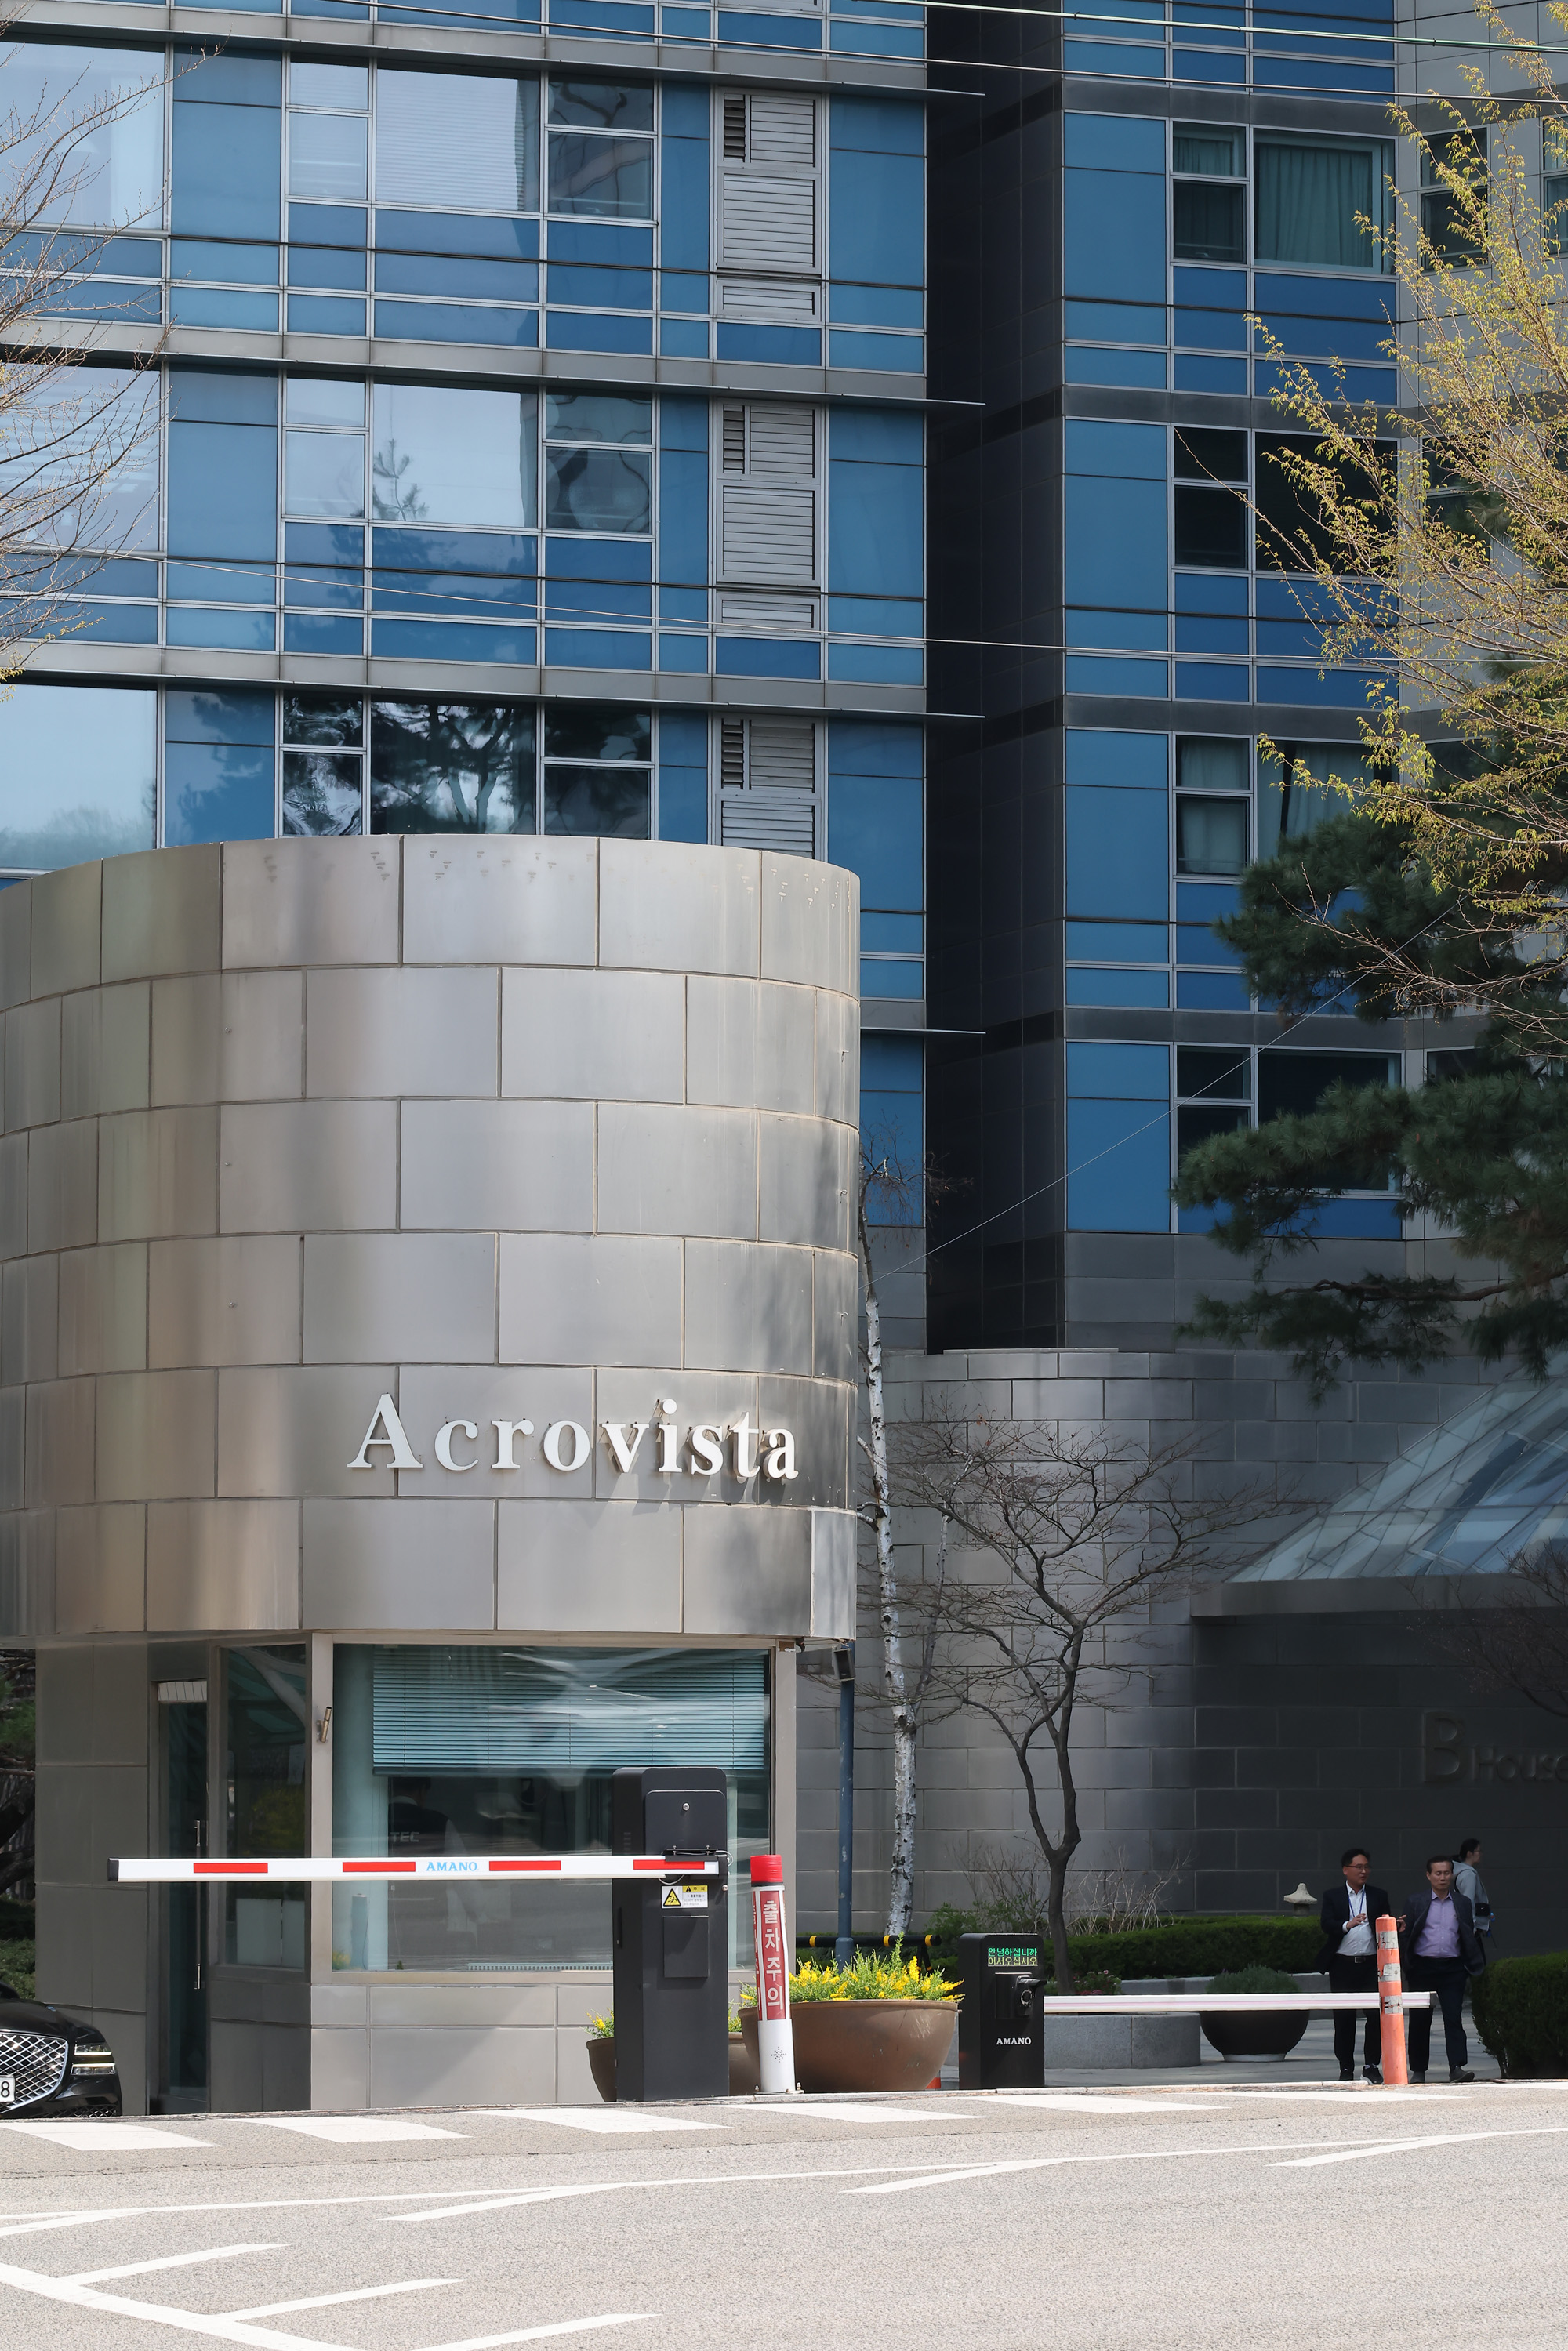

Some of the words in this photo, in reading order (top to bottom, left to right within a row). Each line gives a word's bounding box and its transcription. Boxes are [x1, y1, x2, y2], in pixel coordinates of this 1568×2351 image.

[347, 1392, 798, 1480] Acrovista
[1422, 1709, 1466, 1783] B
[426, 1862, 478, 1871] AMANO
[988, 1947, 1037, 1957] 안녕하십니까
[988, 1957, 1037, 1966] 어서오십시오
[996, 2037, 1032, 2045] AMANO
